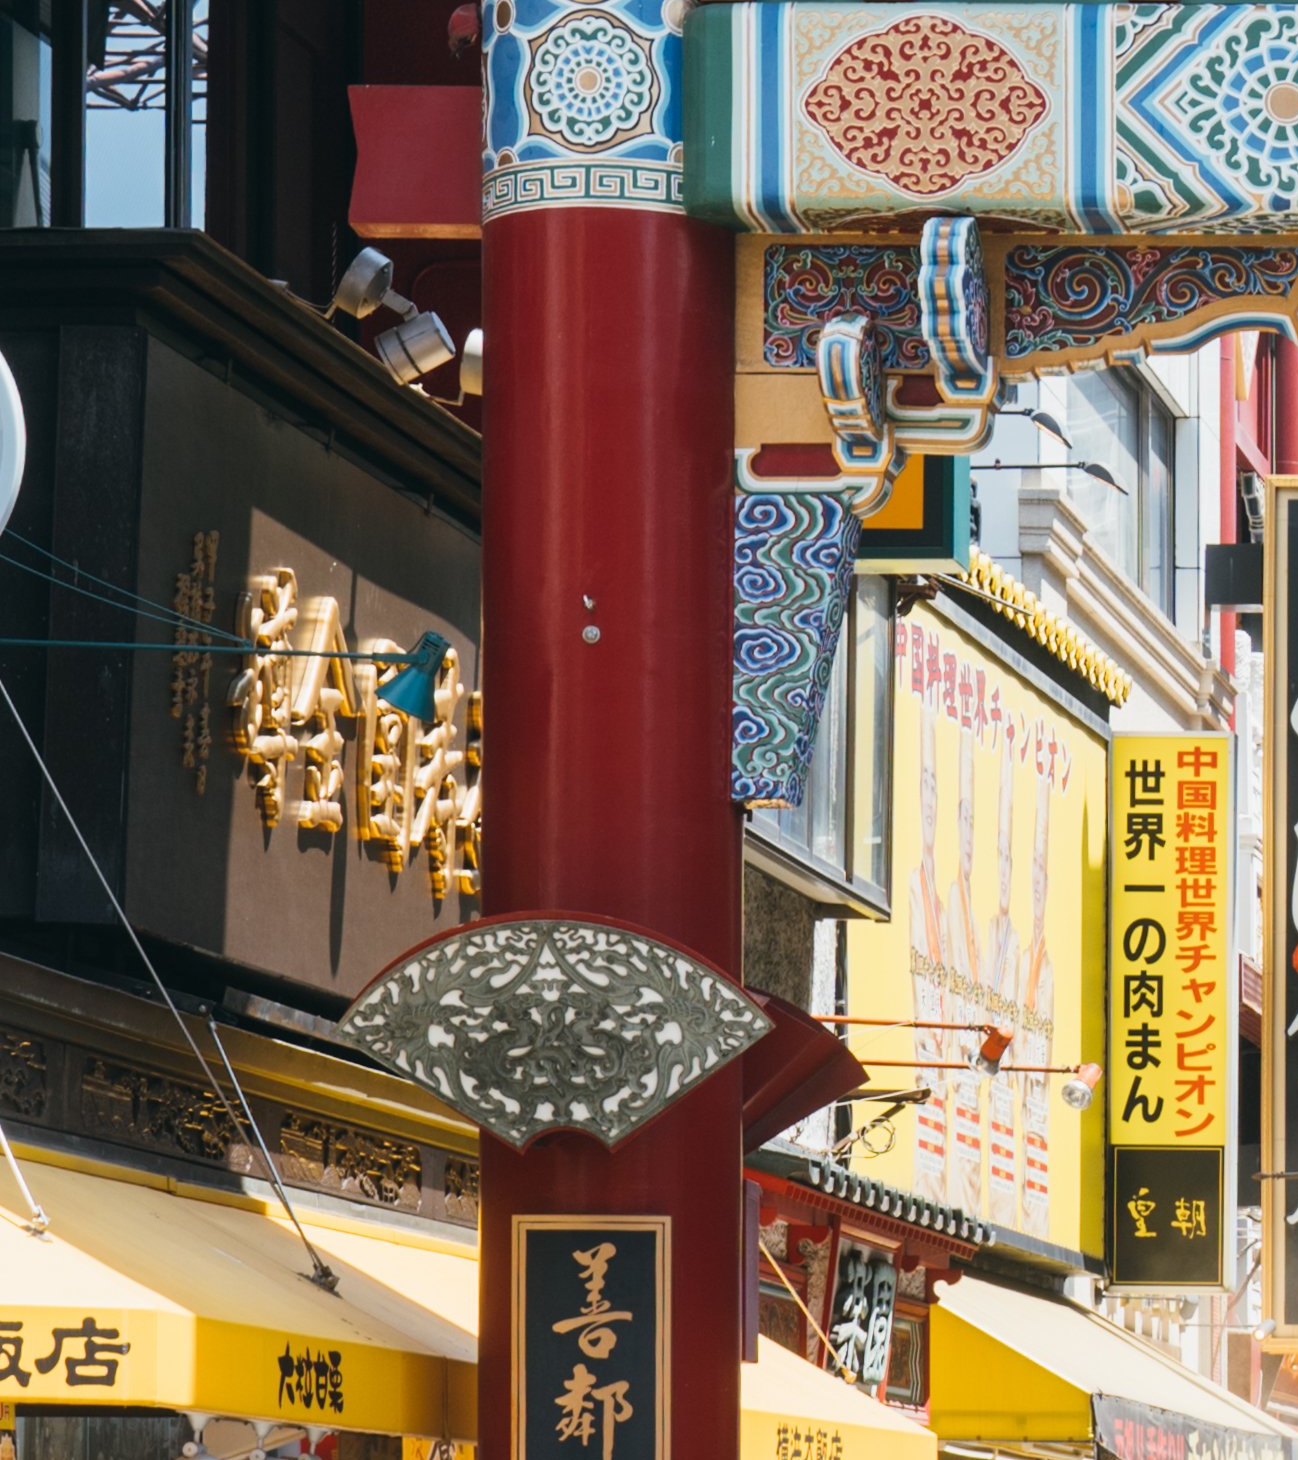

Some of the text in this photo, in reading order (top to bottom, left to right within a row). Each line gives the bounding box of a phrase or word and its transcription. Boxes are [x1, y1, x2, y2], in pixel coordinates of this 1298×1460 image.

[1121, 758, 1167, 1124] 世界一の肉まん
[1174, 745, 1219, 1138] 中国料理世界チャンピオン
[1126, 1186, 1207, 1240] 皇朝
